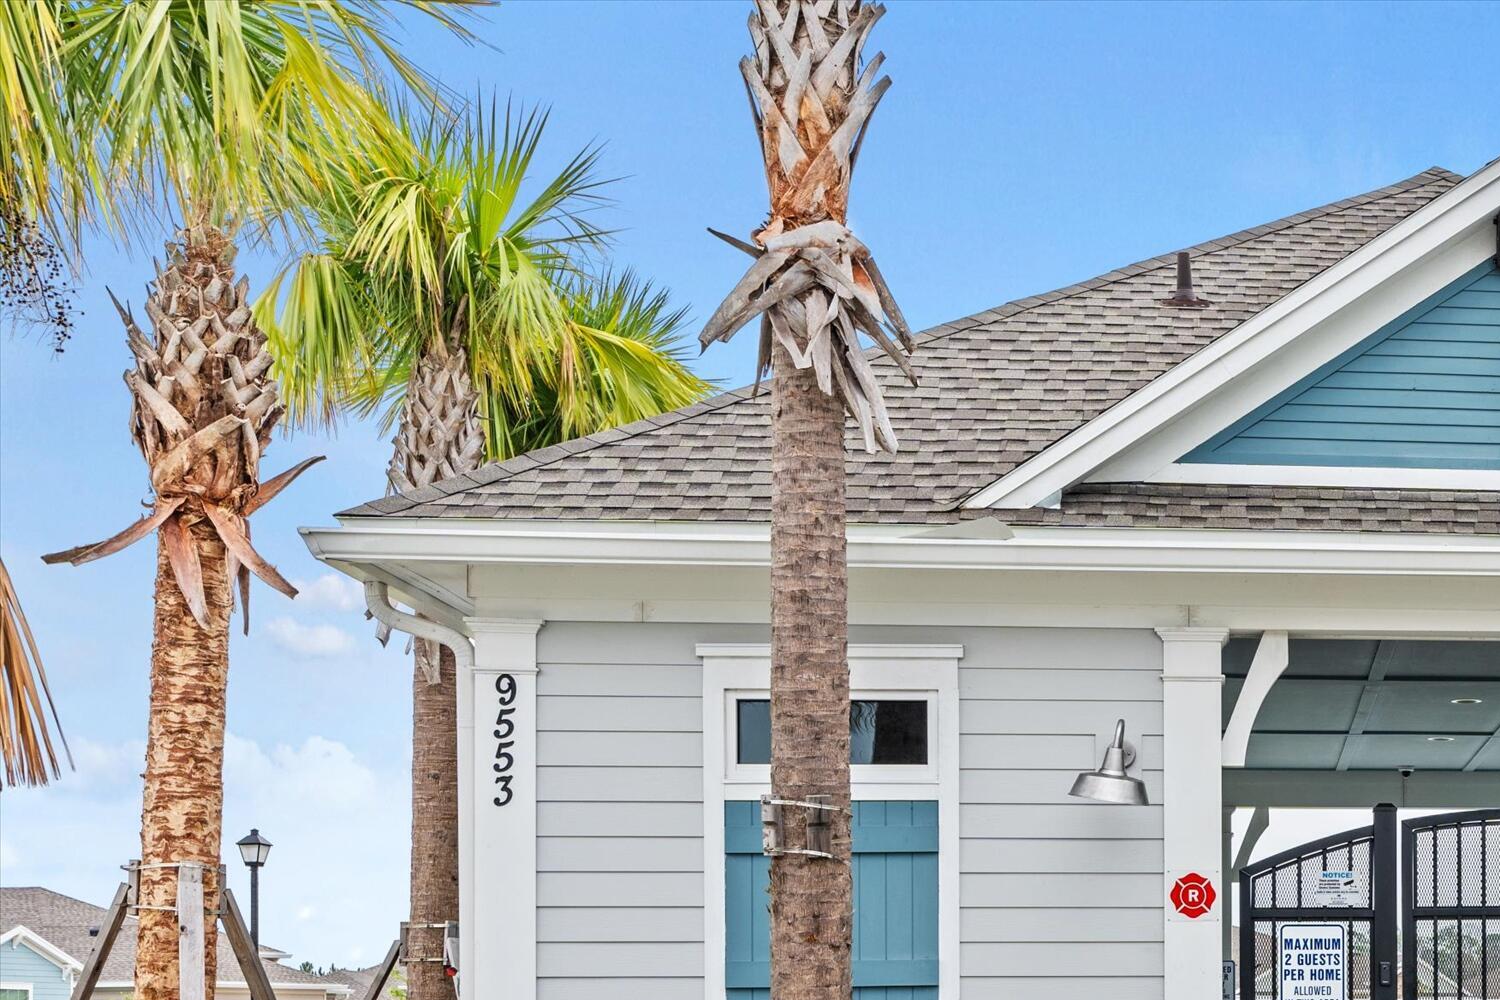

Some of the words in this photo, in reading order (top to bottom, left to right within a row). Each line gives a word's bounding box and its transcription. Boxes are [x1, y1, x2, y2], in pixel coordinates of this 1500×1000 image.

[494, 673, 517, 807] 9553
[1188, 889, 1199, 902] R
[1284, 939, 1340, 950] MAXIMUM
[1285, 954, 1292, 965] 2
[1297, 954, 1340, 965] GUESTS
[1284, 969, 1304, 981] PER
[1311, 969, 1341, 981] HOME
[1294, 986, 1332, 995] ALLOWED
